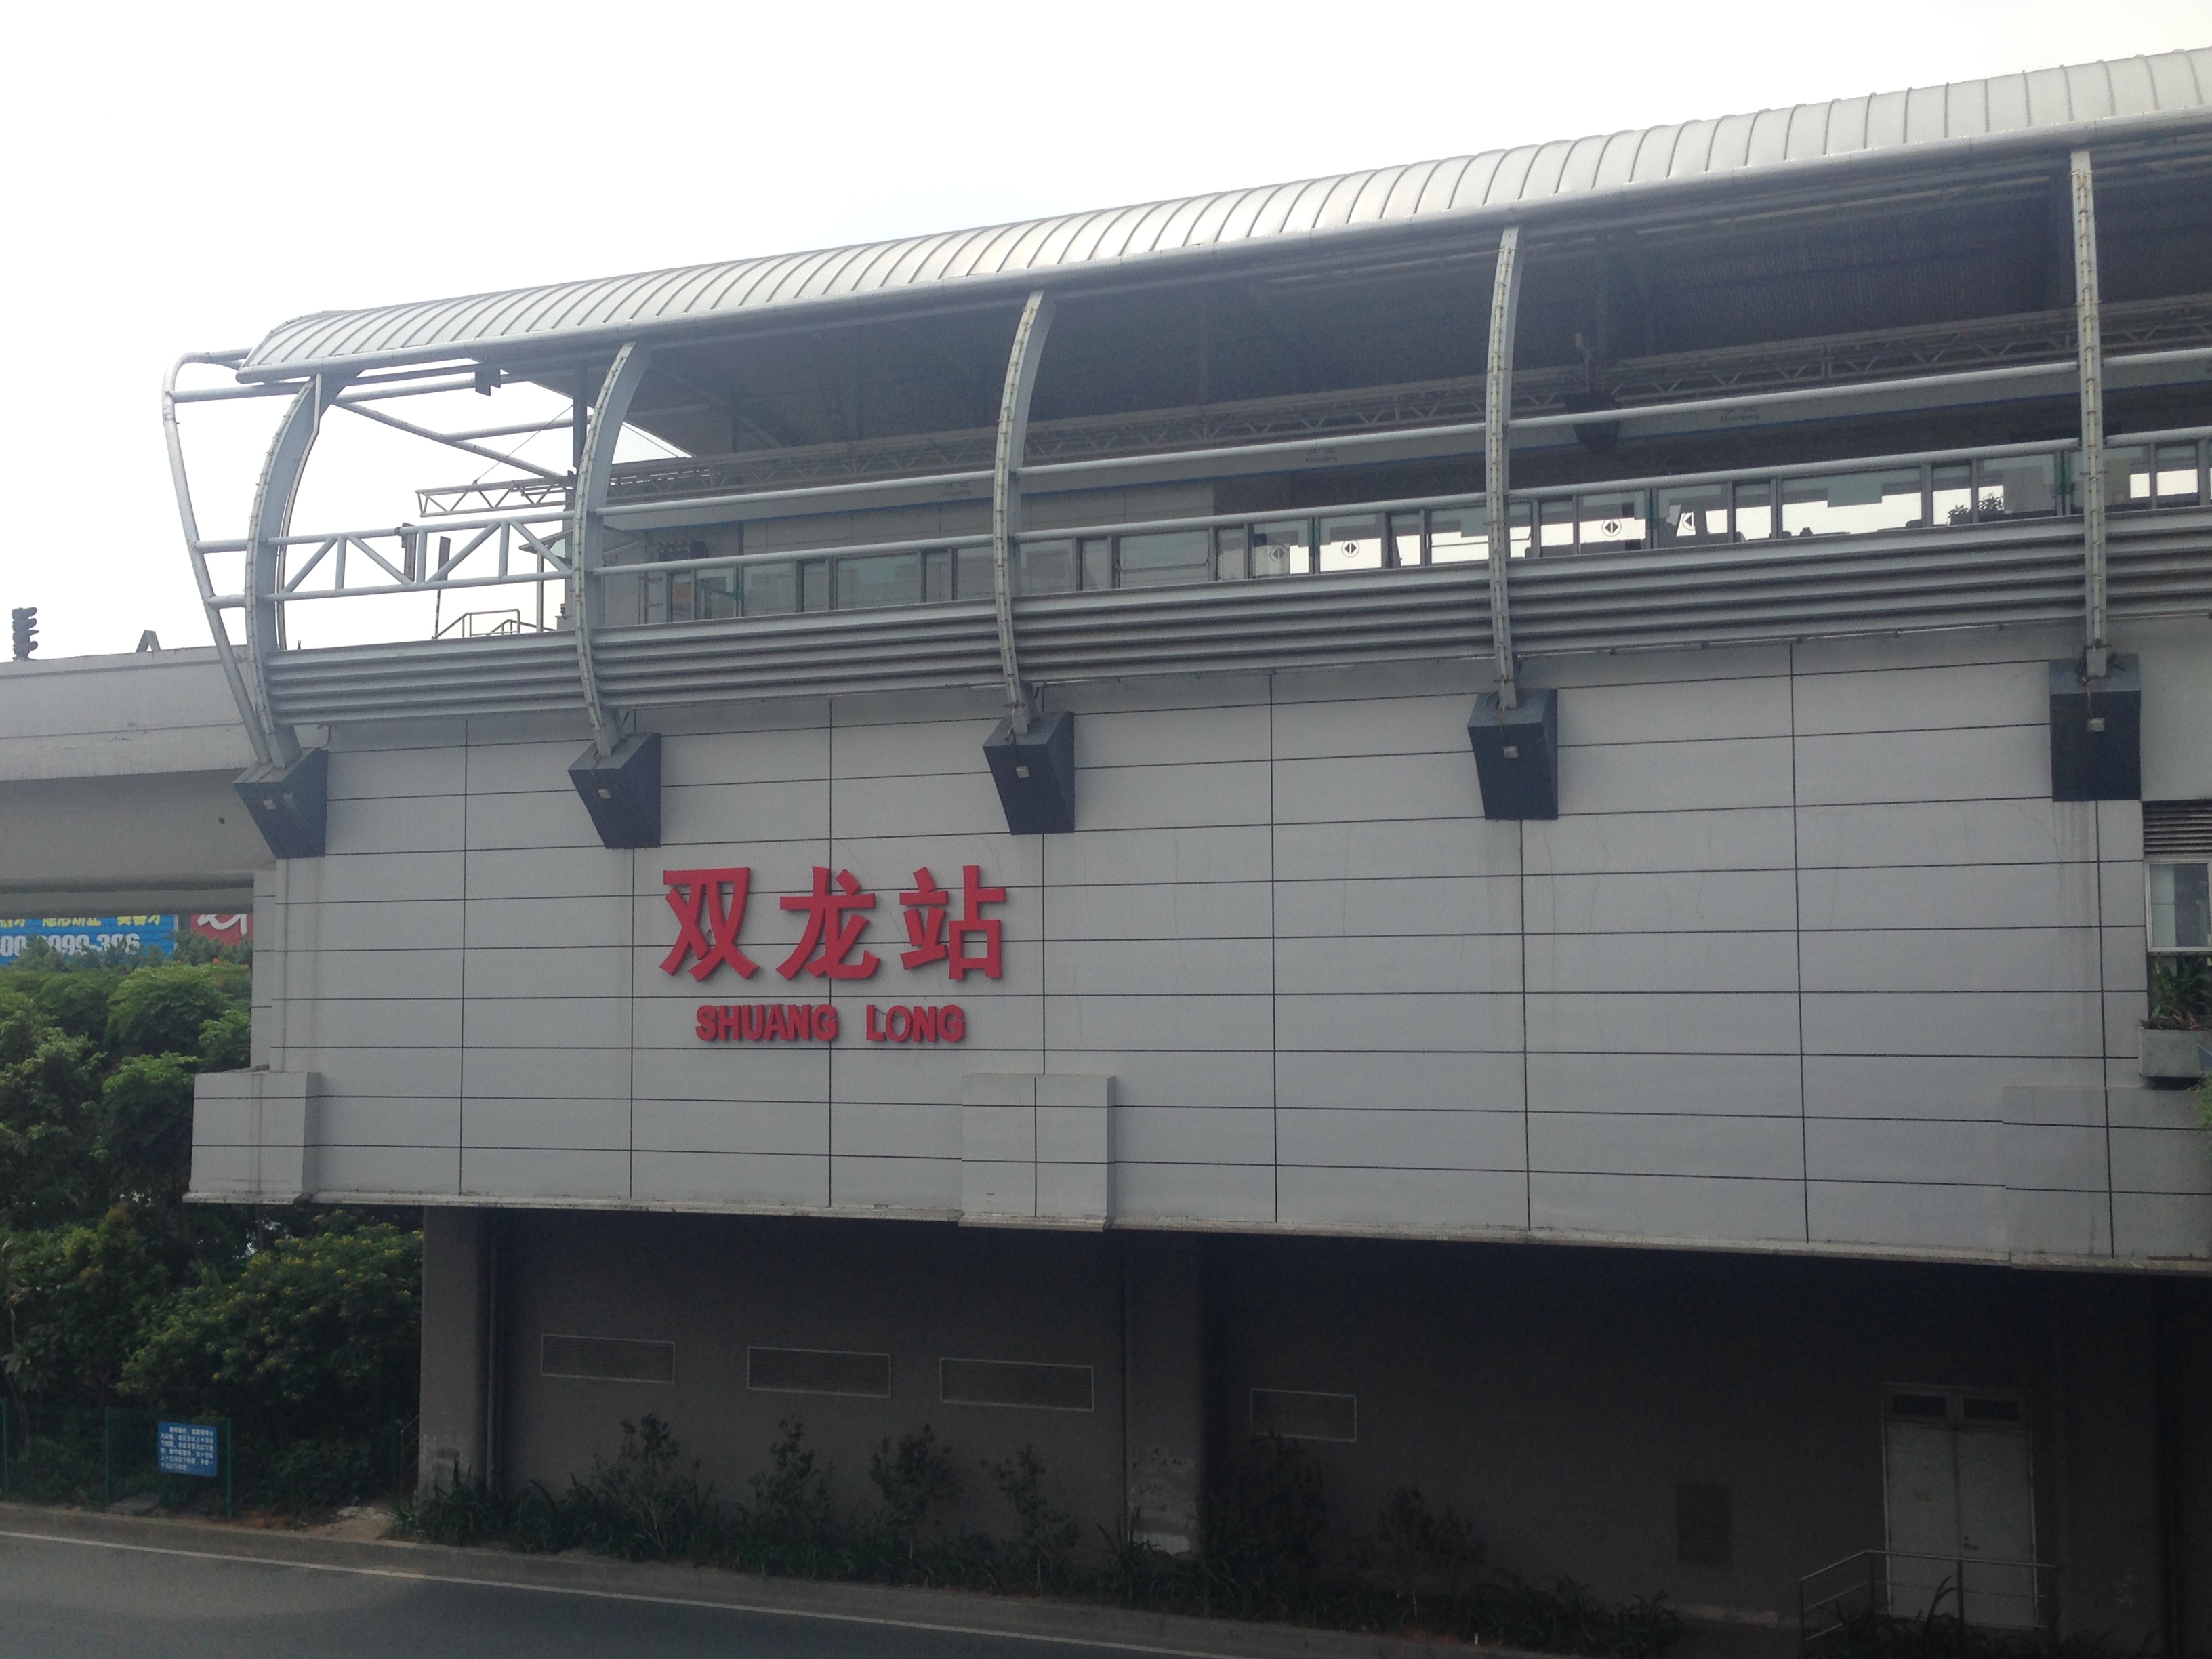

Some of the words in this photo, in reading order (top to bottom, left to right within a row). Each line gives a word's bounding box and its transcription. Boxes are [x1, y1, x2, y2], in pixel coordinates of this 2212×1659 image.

[659, 865, 1006, 982] 双龙站
[695, 1004, 839, 1042] SHUANG
[866, 1004, 965, 1043] LONG
